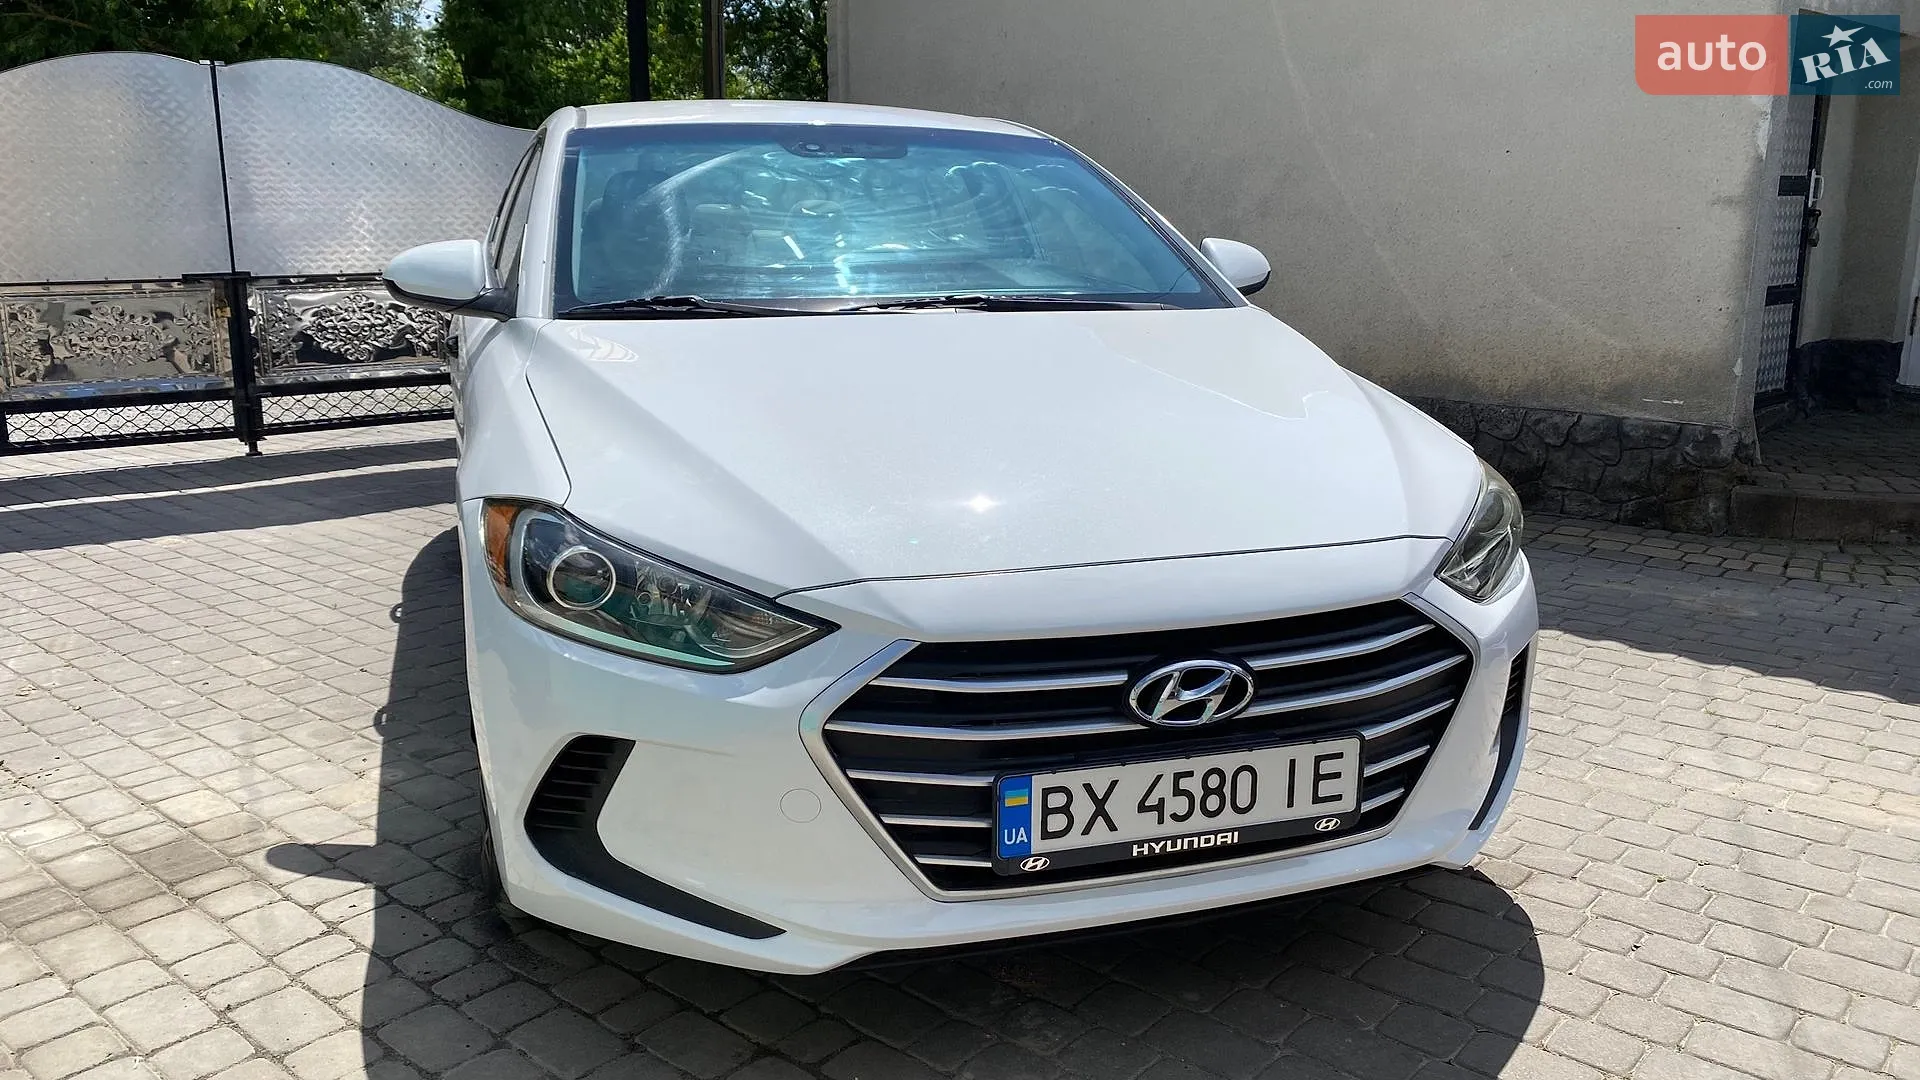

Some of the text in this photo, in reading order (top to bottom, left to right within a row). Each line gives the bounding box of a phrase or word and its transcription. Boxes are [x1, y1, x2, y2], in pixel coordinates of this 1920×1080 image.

[1040, 751, 1345, 841] BX 4580 IE
[1004, 826, 1028, 846] UA
[1132, 831, 1239, 857] HYUNDAI
